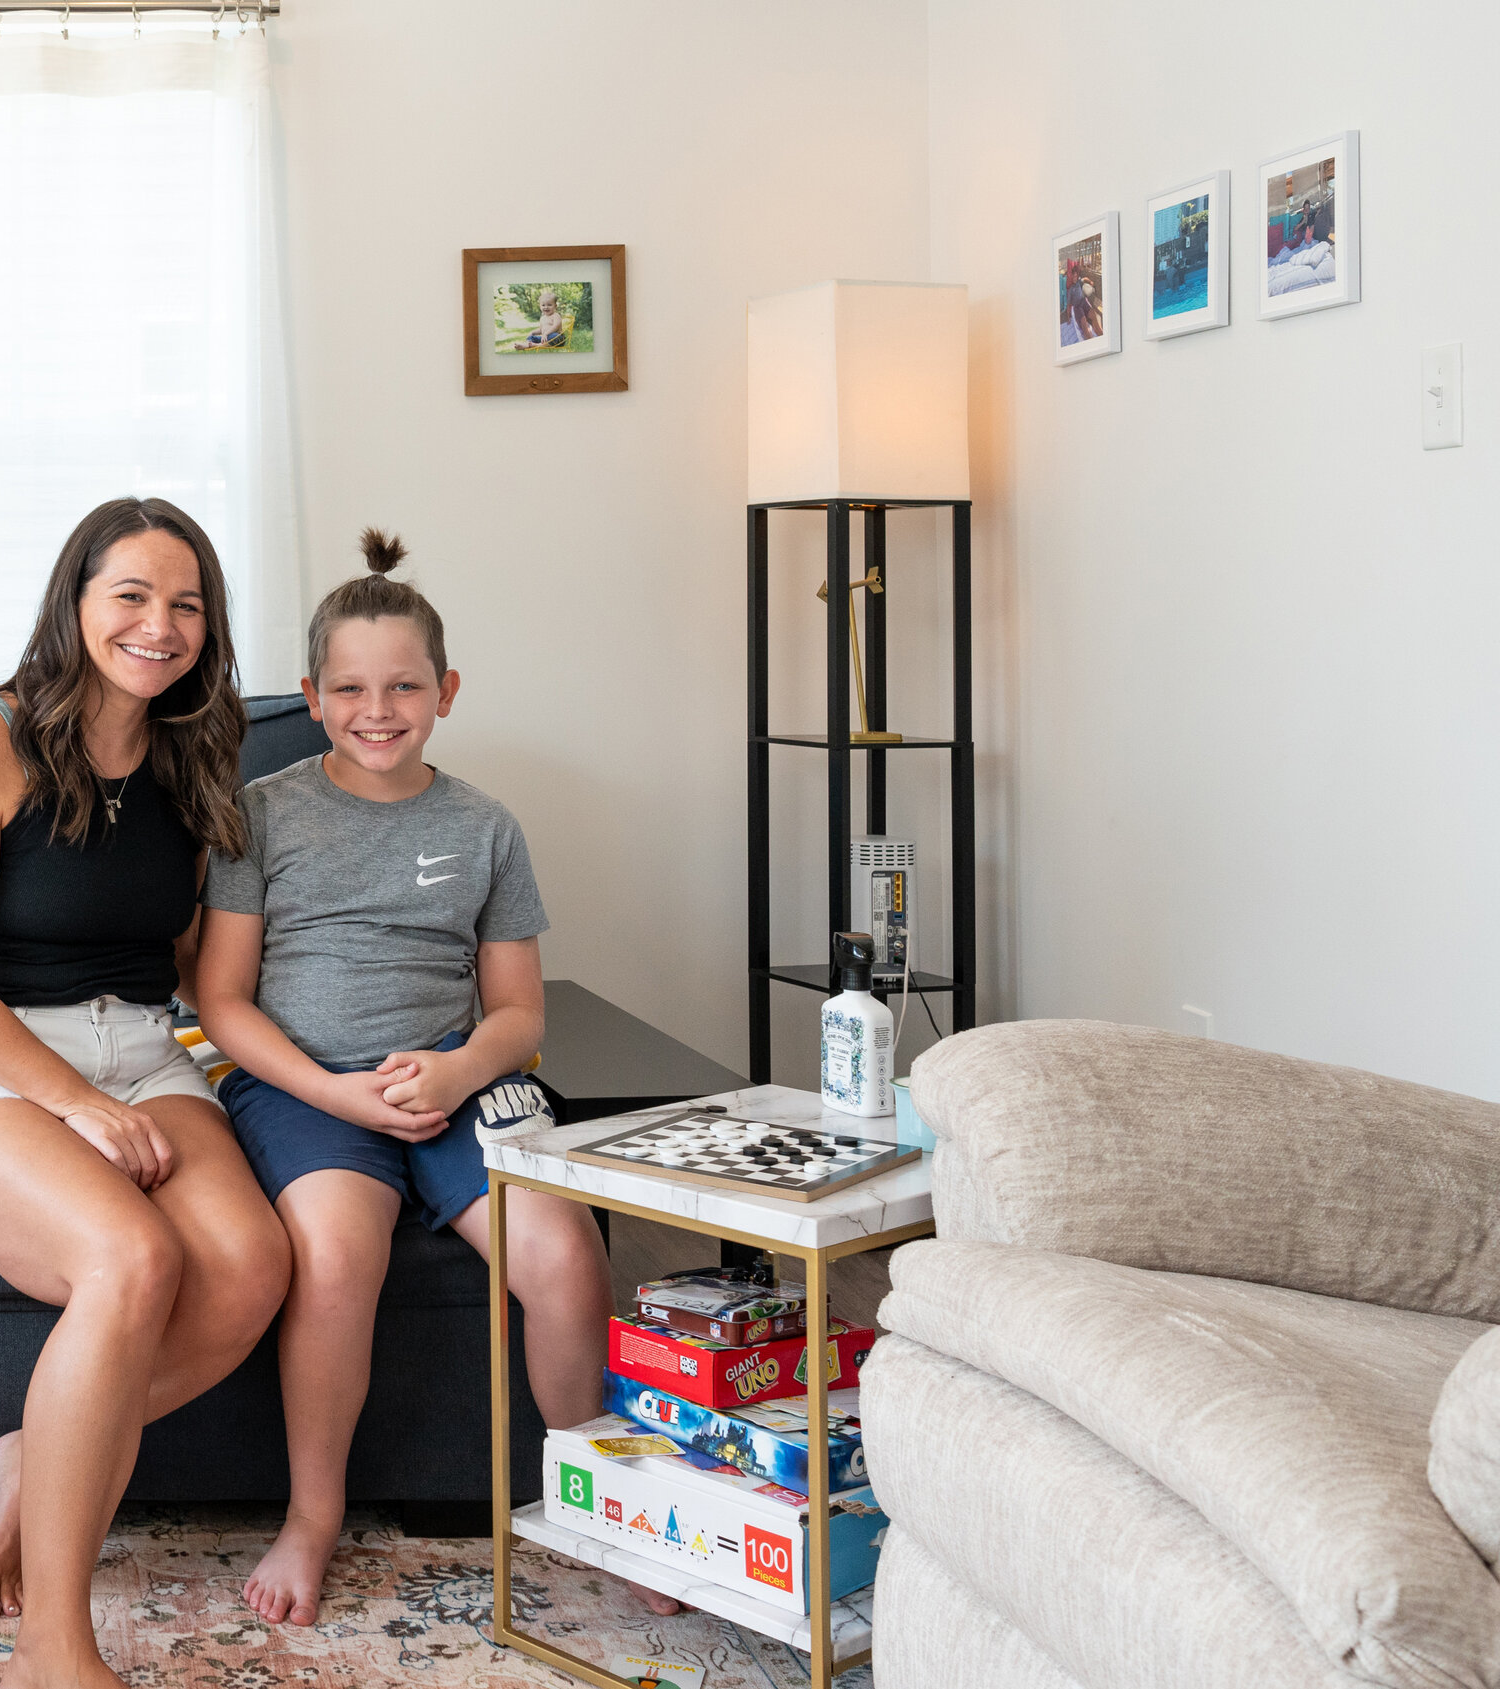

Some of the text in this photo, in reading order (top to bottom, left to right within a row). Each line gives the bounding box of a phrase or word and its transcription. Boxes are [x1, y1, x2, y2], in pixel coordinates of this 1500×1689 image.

[746, 1318, 769, 1342] UNO
[725, 1351, 760, 1382] GIANT
[734, 1358, 780, 1401] UNO
[638, 1389, 680, 1425] CLUE
[569, 1474, 584, 1502] 8
[606, 1504, 620, 1518] 46
[635, 1518, 649, 1532] 12
[666, 1527, 679, 1541] 14
[746, 1538, 789, 1573] 100
[753, 1567, 786, 1588] Pieces
[625, 1657, 697, 1673] WAITRESS
